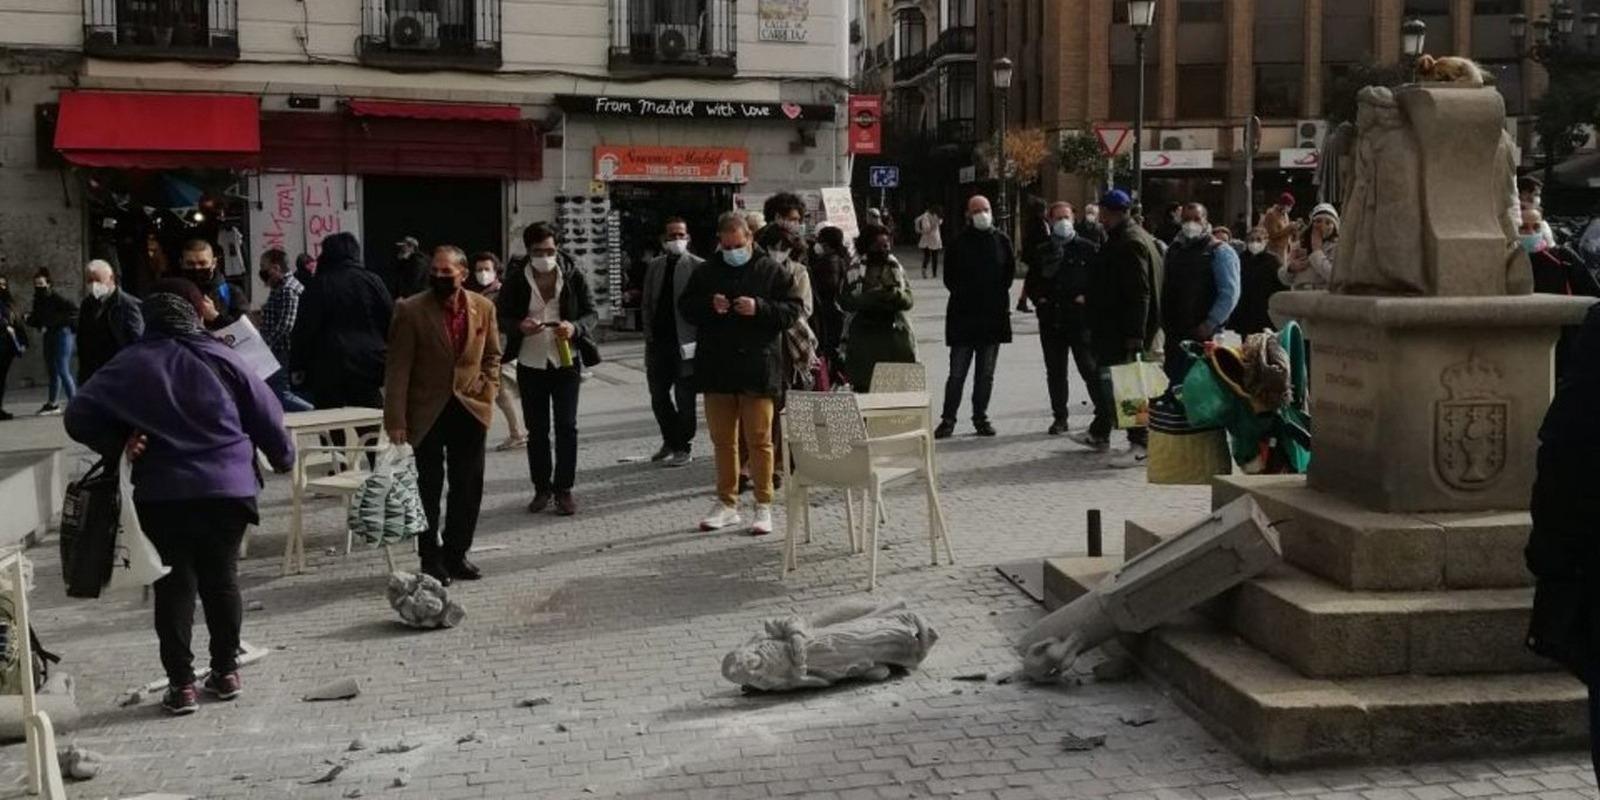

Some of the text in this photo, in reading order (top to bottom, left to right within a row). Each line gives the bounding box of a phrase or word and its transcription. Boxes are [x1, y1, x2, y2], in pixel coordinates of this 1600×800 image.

[595, 97, 632, 112] From
[638, 99, 695, 116] Madrid
[706, 101, 736, 116] with
[270, 173, 298, 231] TOTAL
